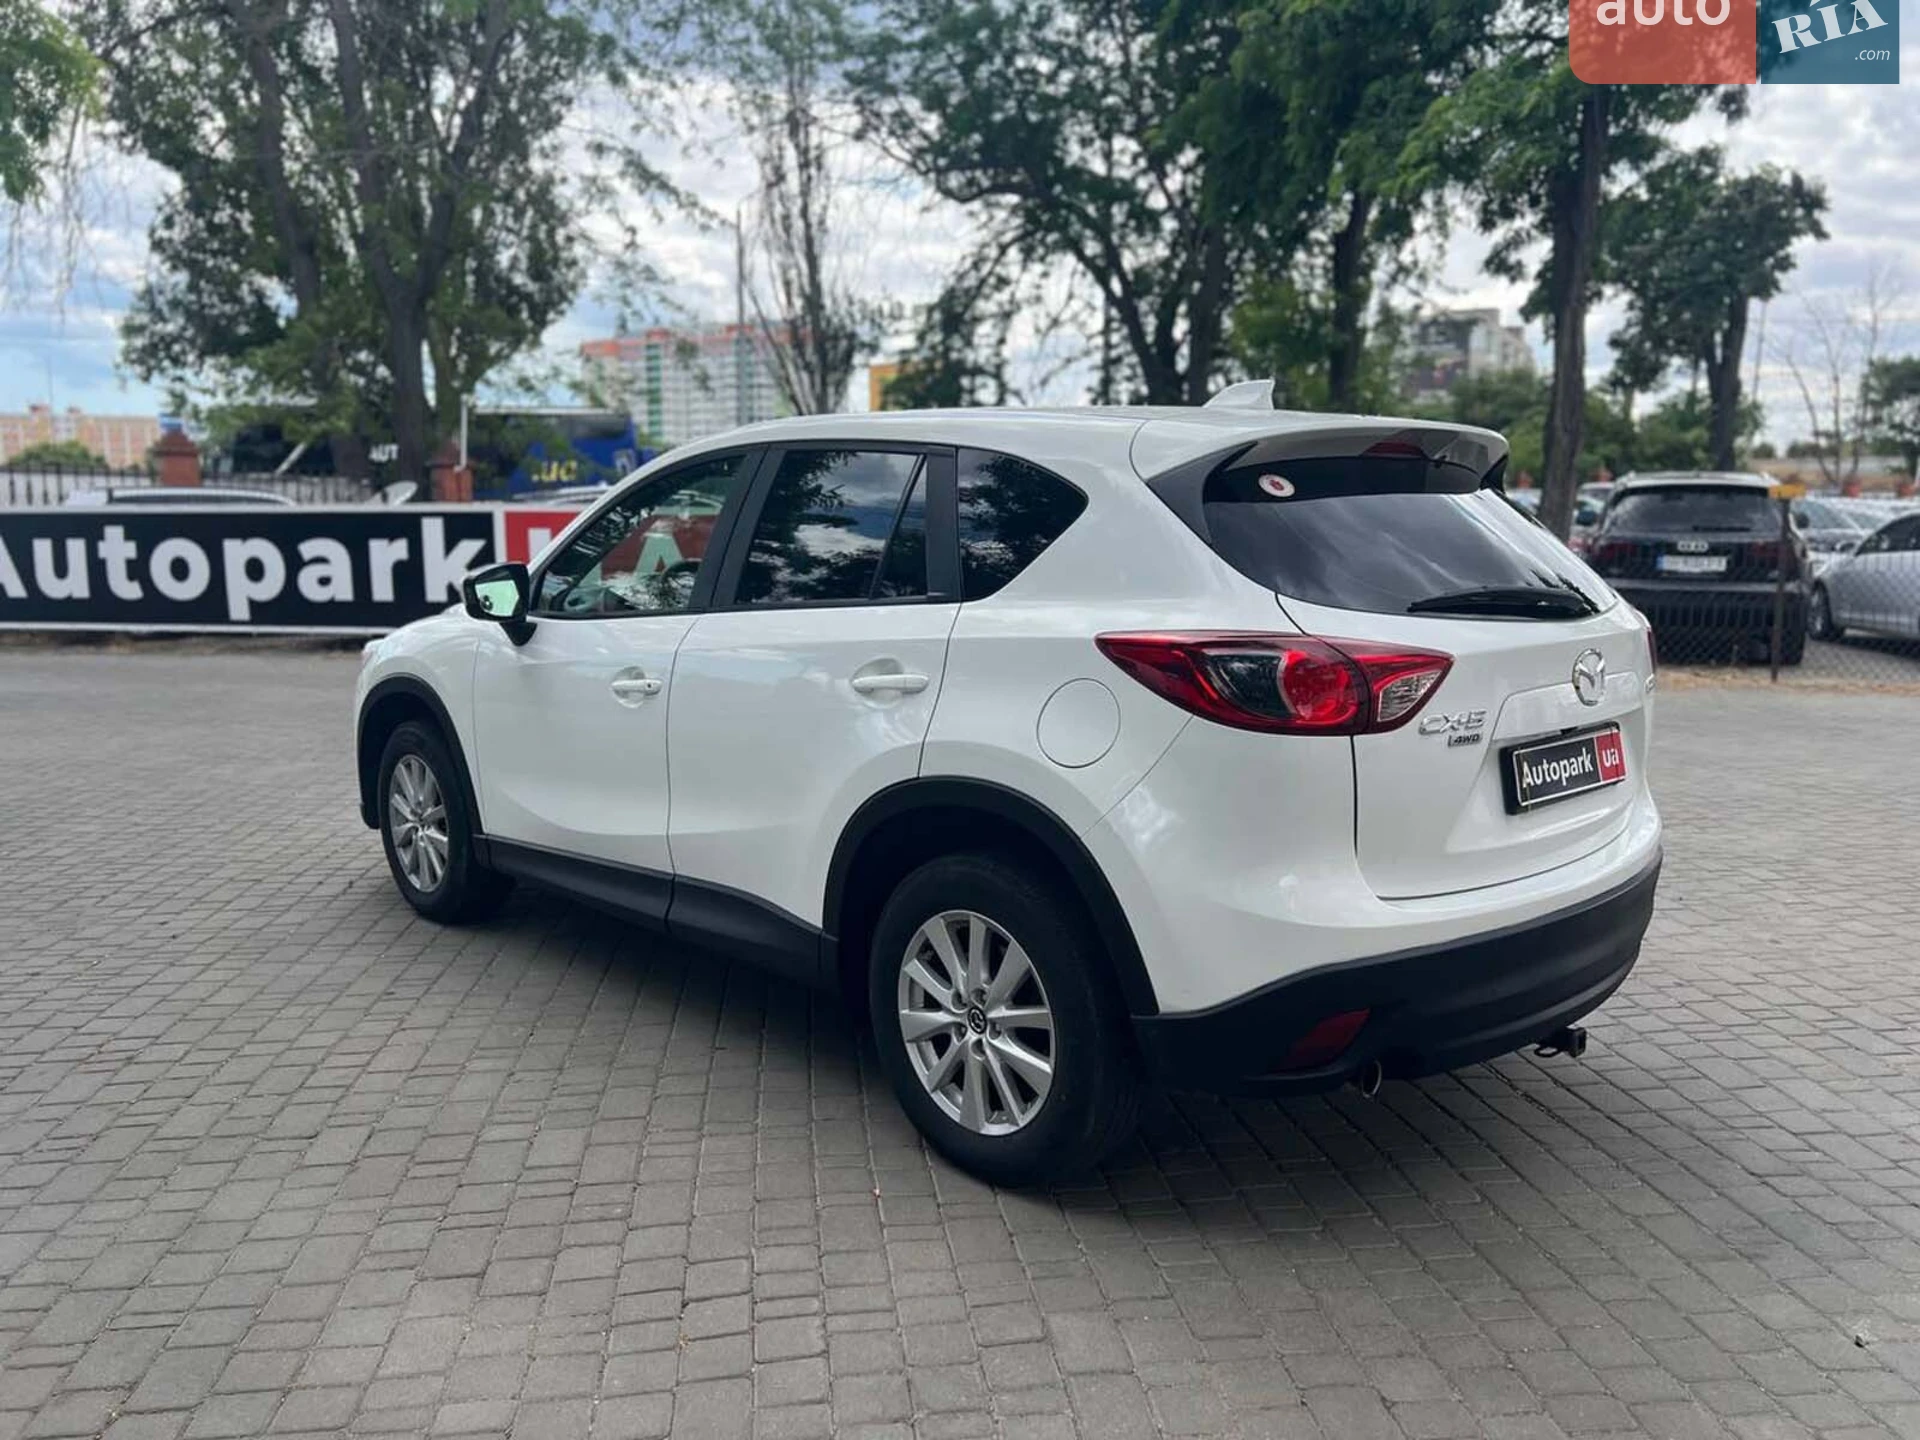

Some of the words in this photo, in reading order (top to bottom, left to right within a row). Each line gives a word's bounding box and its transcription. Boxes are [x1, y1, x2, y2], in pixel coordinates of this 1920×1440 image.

[1419, 710, 1487, 735] CX-5
[1453, 733, 1480, 744] 4WD
[1522, 747, 1594, 788] Autopark
[1602, 748, 1620, 768] ua
